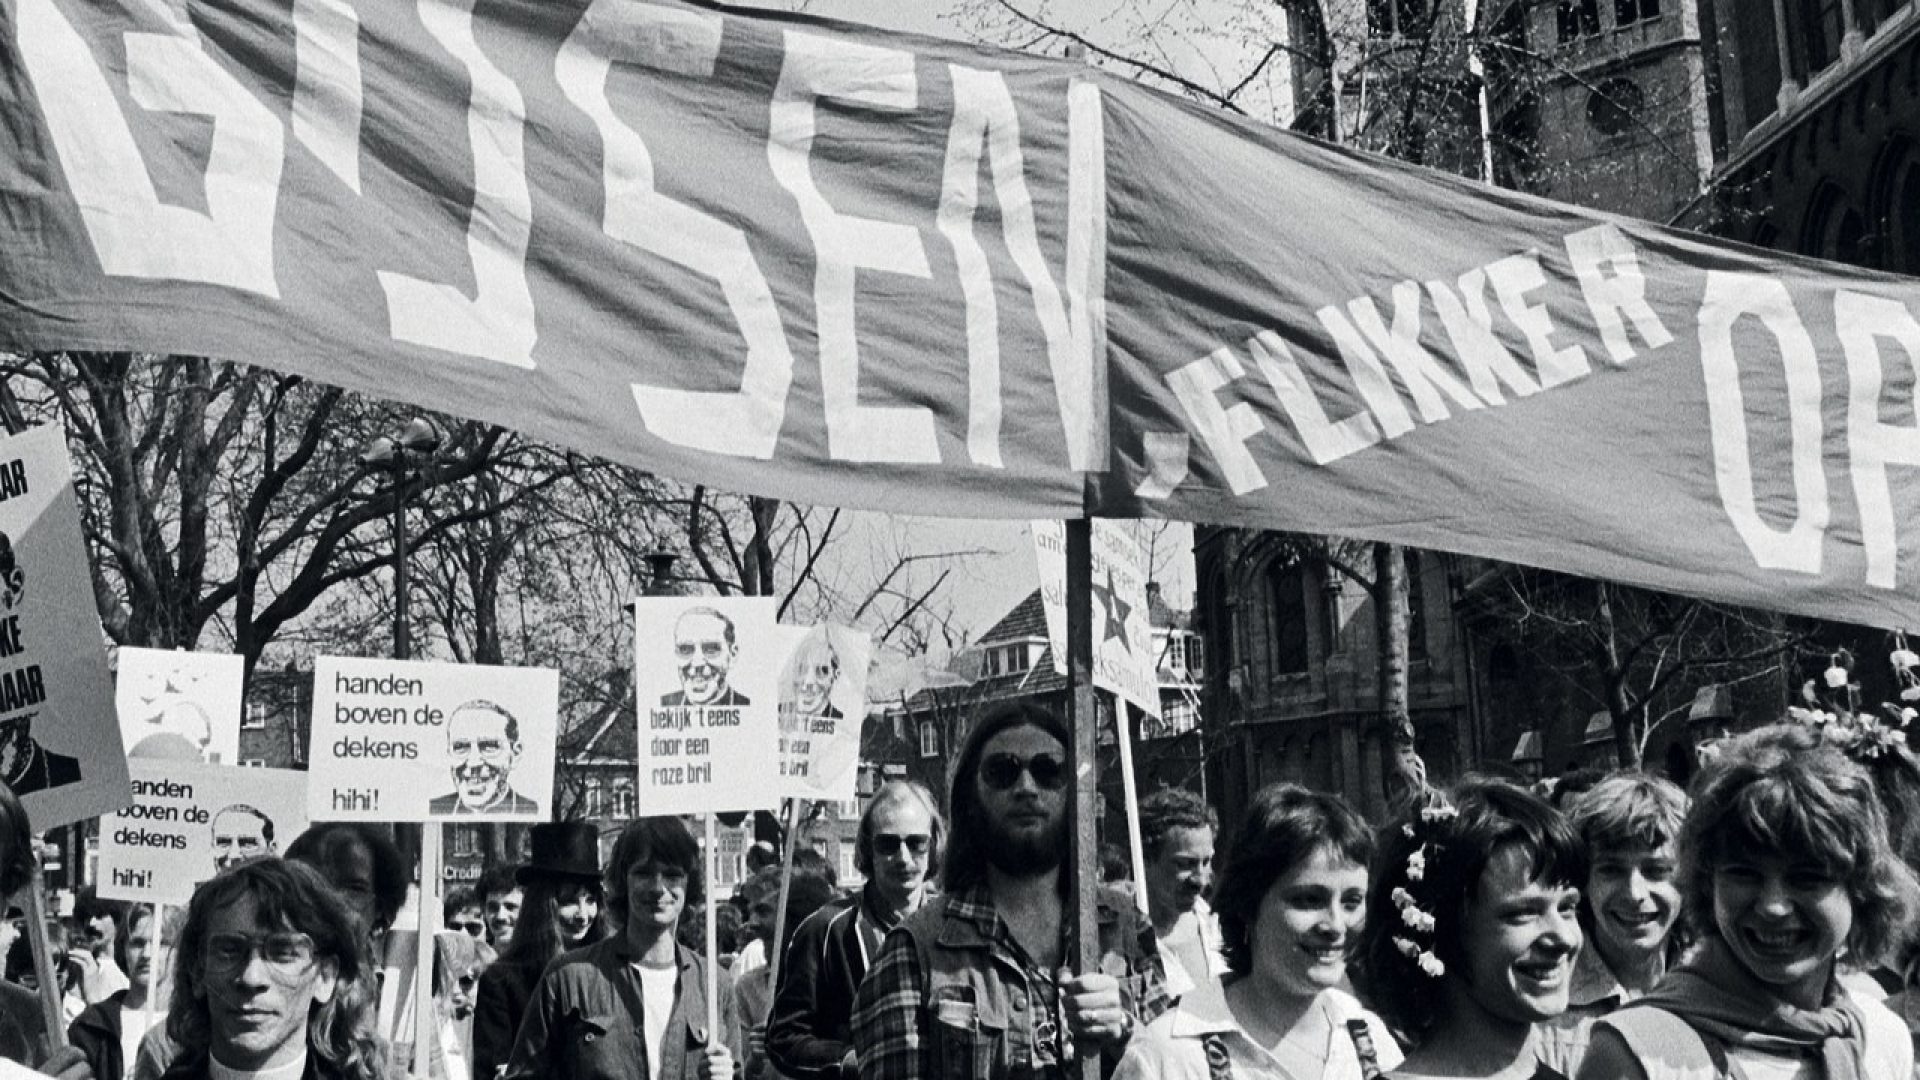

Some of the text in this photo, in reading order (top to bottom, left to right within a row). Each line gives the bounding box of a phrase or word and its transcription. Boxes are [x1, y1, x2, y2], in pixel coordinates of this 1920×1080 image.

[1164, 223, 1674, 496] FLIKKER
[1697, 271, 1920, 589] OP
[0, 459, 28, 502] AR
[0, 665, 46, 713] AAR
[335, 671, 423, 696] handen
[335, 701, 444, 726] boven de
[650, 707, 691, 732] bekijk
[707, 709, 740, 727] eens
[333, 735, 418, 760] dekens
[651, 736, 709, 756] door een
[652, 761, 712, 786] roze bril
[131, 778, 193, 799] anden
[332, 788, 379, 811] hihi!
[183, 805, 209, 824] de
[114, 826, 187, 850] dekens
[112, 867, 152, 888] hihi!
